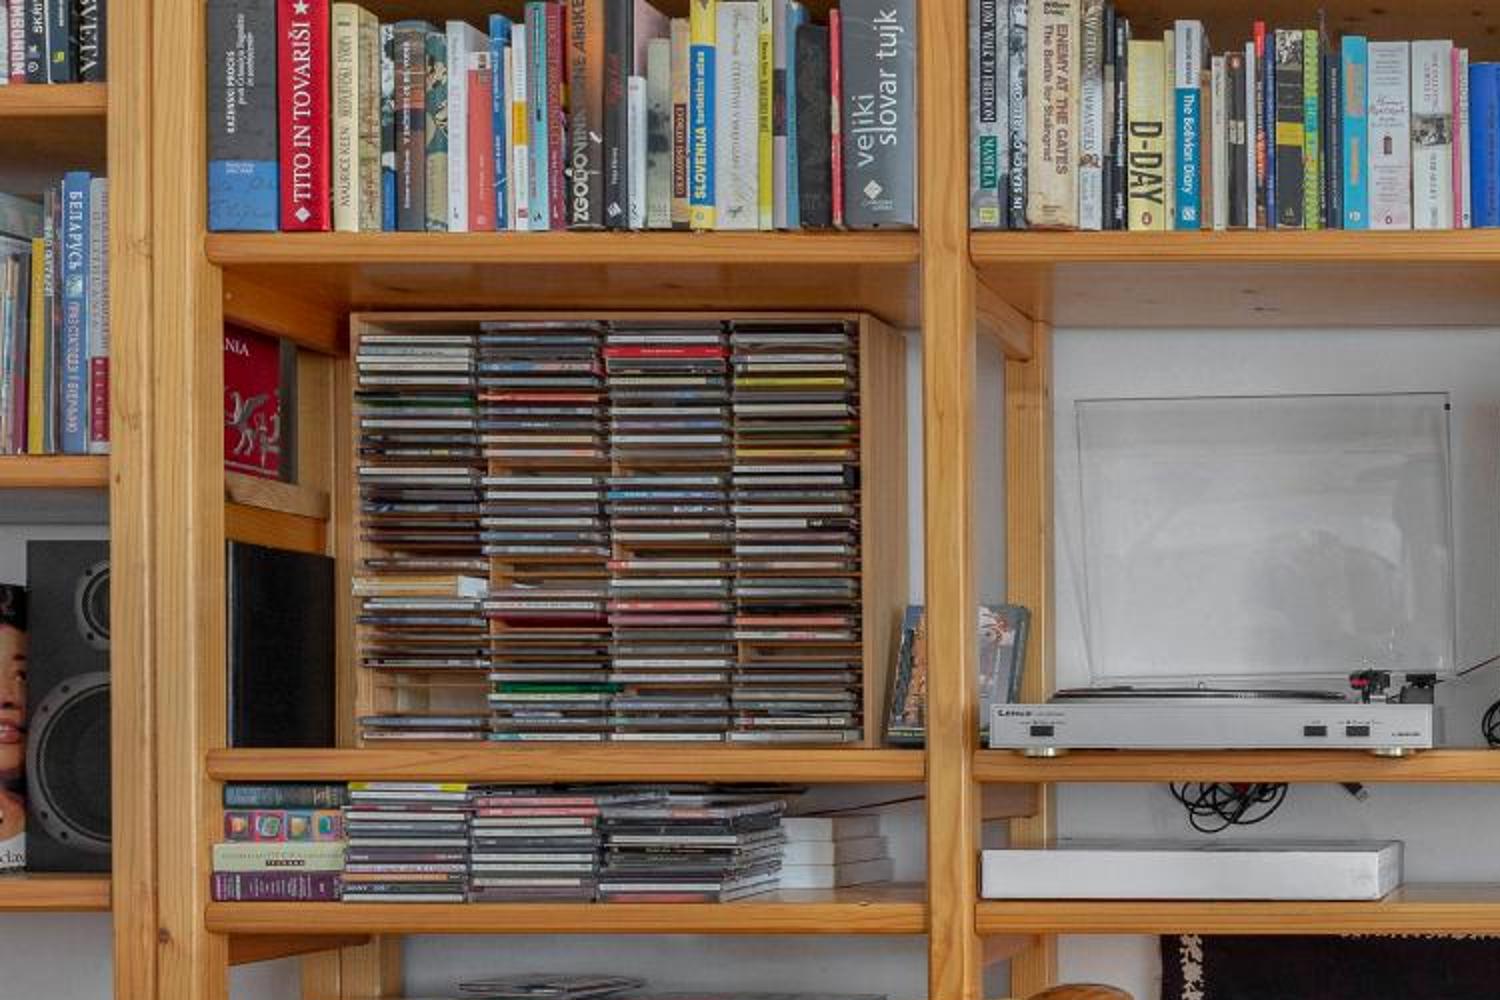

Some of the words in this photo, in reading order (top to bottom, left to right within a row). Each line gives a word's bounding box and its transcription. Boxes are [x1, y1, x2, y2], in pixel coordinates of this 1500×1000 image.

[872, 8, 905, 57] tujk
[1043, 24, 1054, 45] The
[1056, 23, 1069, 75] ENEMY
[287, 22, 311, 121] TOVARIŠI
[1043, 49, 1054, 83] Battle
[1056, 75, 1069, 94] AT
[876, 68, 898, 147] slovar
[1043, 85, 1054, 102] for
[1056, 97, 1069, 125] THE
[1183, 94, 1196, 115] The
[293, 124, 311, 148] IN
[338, 126, 351, 155] KEEN
[852, 96, 875, 168] veliki
[1041, 105, 1054, 162] Stalingrad
[1056, 128, 1069, 175] GATES
[1183, 116, 1196, 162] Bolivian
[293, 153, 311, 203] TITO
[338, 156, 351, 207] MAURICE
[694, 127, 707, 199] SLOVENIJA
[1129, 121, 1163, 205] D-DAY
[1181, 163, 1196, 194] Diary
[1012, 196, 1023, 210] IN
[66, 191, 83, 271] БЕЛАРУСЬ
[997, 709, 1033, 718] Lenco
